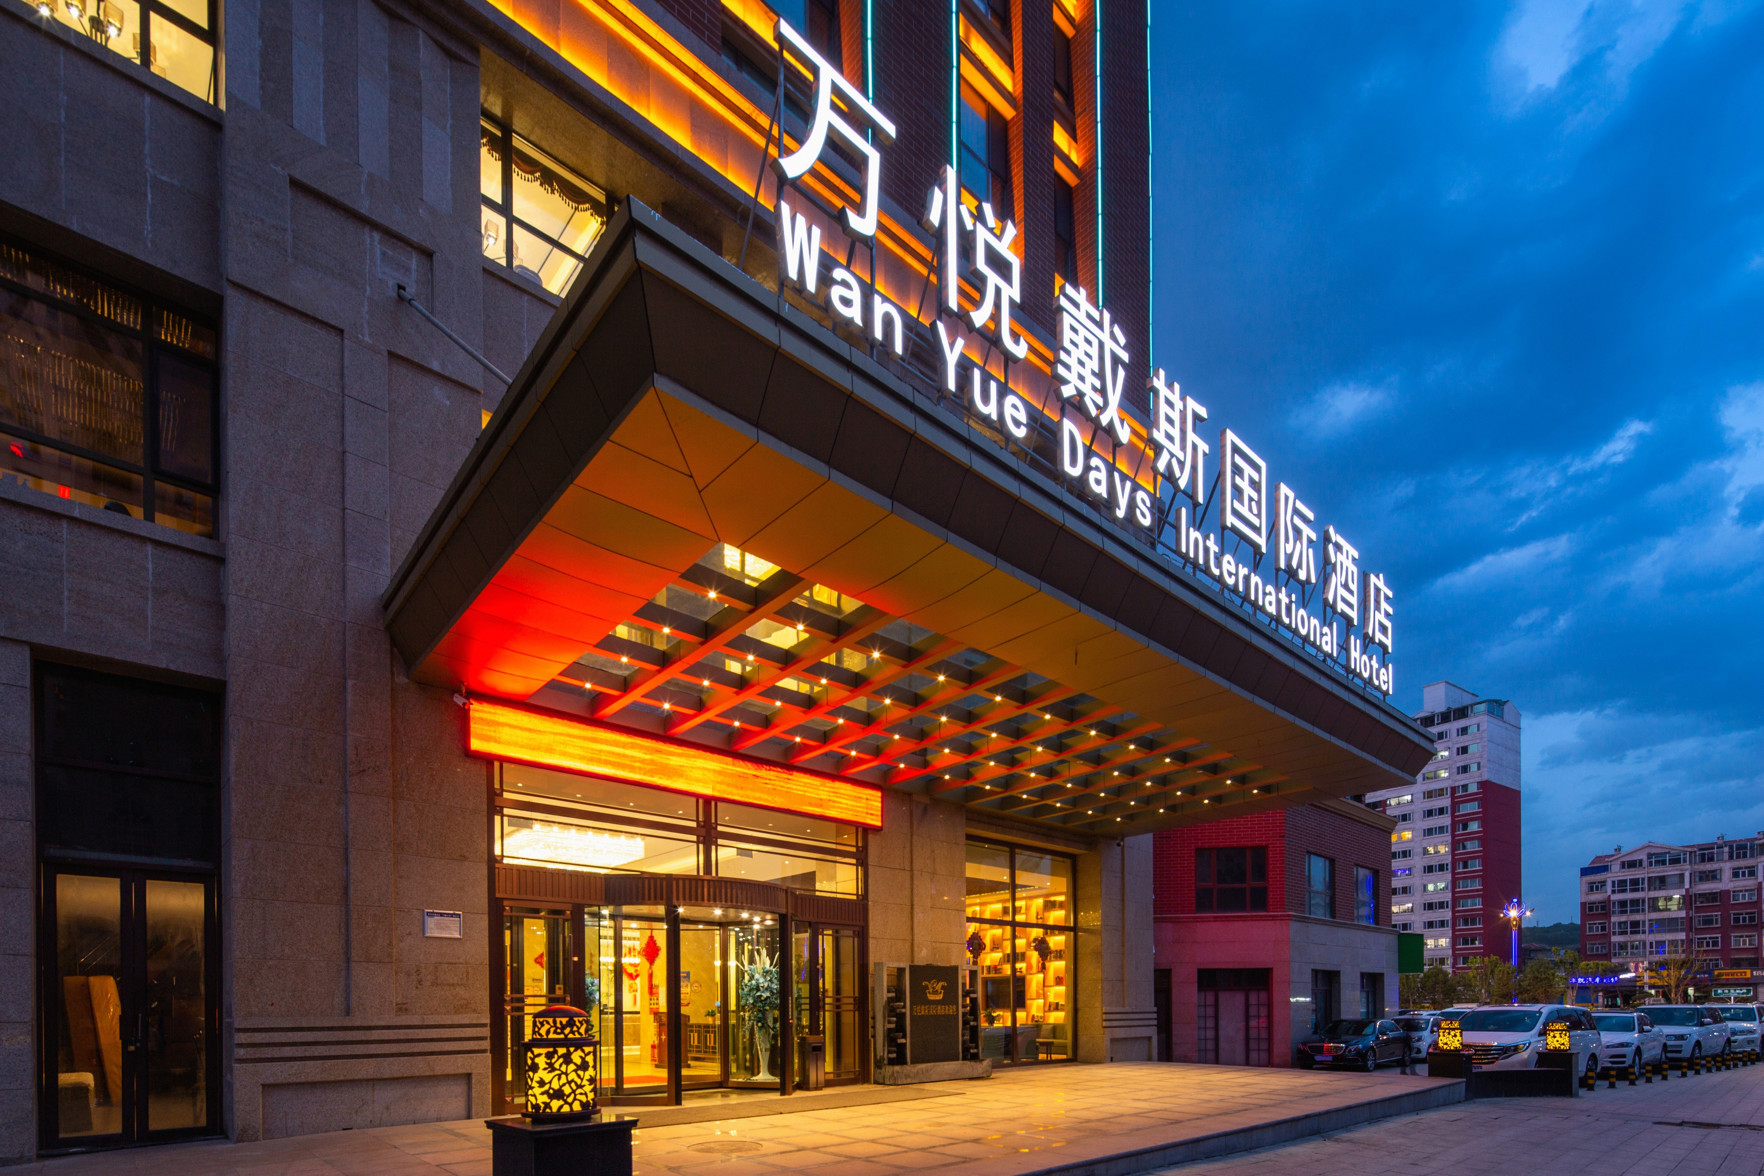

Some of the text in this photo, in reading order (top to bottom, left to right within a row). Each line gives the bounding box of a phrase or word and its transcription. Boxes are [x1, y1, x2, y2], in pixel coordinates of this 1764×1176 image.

[777, 17, 1394, 654] 万悦戴斯国际酒店
[779, 200, 1394, 695] Wan Yue Days International Hotel
